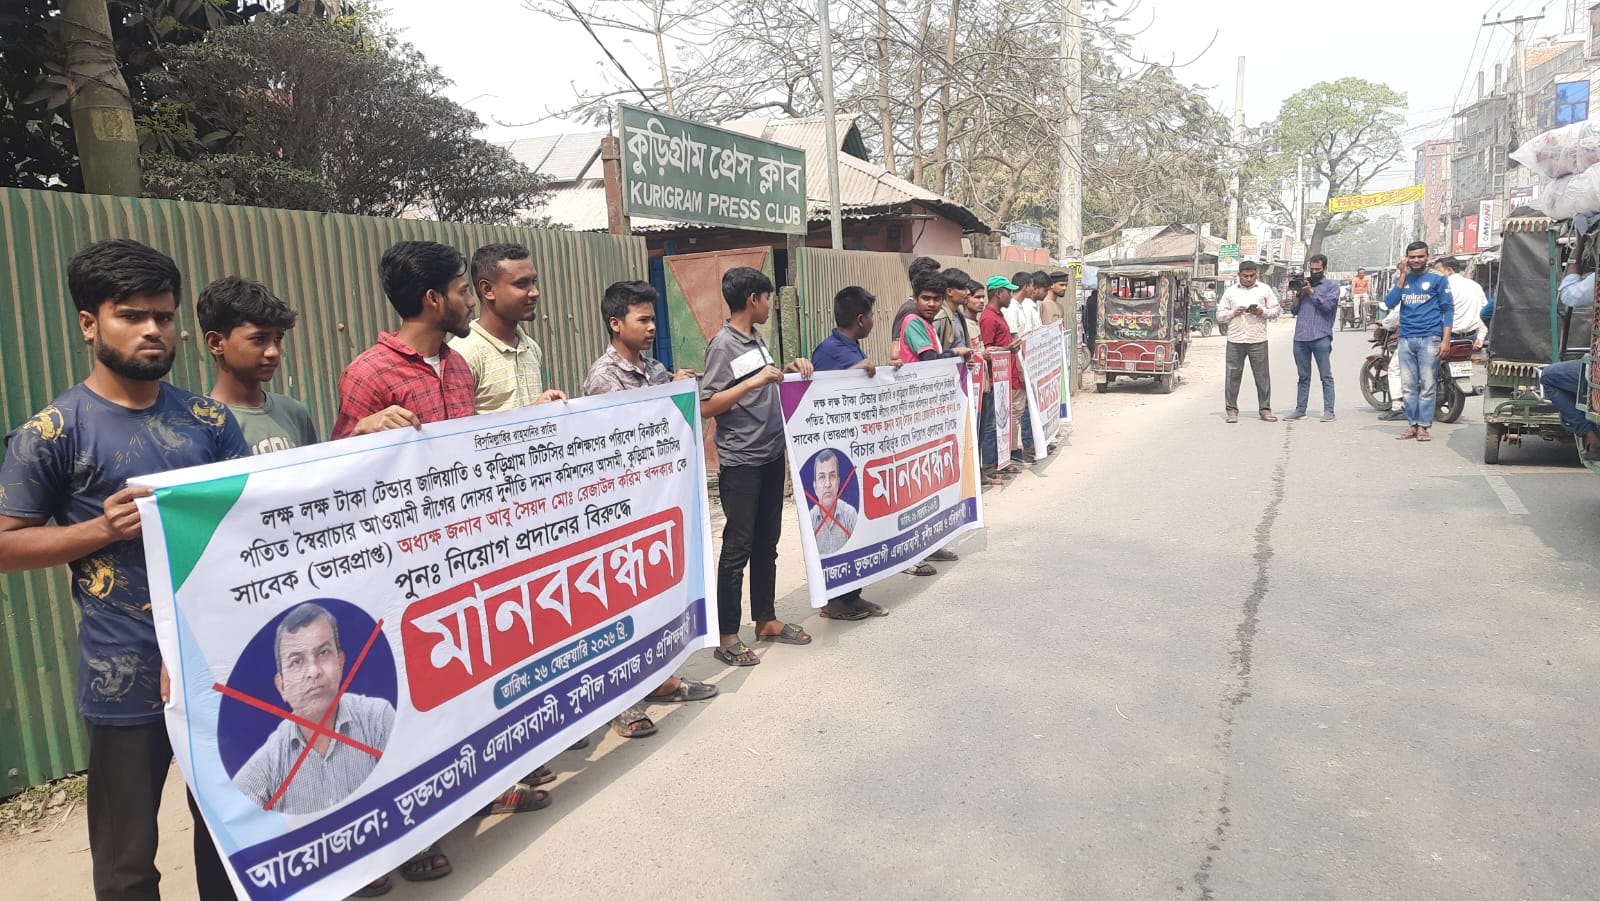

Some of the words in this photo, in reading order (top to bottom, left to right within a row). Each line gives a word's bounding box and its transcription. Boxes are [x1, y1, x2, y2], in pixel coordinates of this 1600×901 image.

[625, 117, 707, 176] কুড়িগ্রাম
[710, 143, 753, 184] প্রেস
[758, 154, 801, 195] ক্লাব
[630, 180, 703, 213] KURIGRAM
[708, 194, 761, 221] PRESS
[766, 203, 801, 225] CLUB
[792, 430, 821, 446] সাবেক
[823, 426, 859, 445] (ভারপ্রাপ্ত)
[805, 413, 825, 429] পতিত
[842, 394, 857, 407] টাকা
[260, 505, 294, 530] লক্ষ
[299, 497, 329, 521] লক্ষ
[334, 488, 366, 512] টাকা
[371, 478, 412, 505] টেন্ডার
[416, 461, 469, 493] জালিয়াতি
[472, 464, 483, 477] ও
[484, 452, 526, 480] কুড়িগ্রাম
[528, 441, 564, 465] টিটিসির
[567, 434, 606, 458] প্রশিক্ষণের
[608, 427, 636, 446] পরিবেশ
[850, 441, 875, 458] বিচার
[866, 439, 955, 507] মানববন্ধন
[230, 569, 299, 605] সাবেক
[307, 541, 393, 590] (ভারপ্রাপ্ত)
[397, 527, 442, 555] অধ্যক্ষ
[444, 515, 482, 541] জনাব
[486, 504, 513, 527] আবু
[513, 495, 547, 521] সৈয়দ
[551, 490, 574, 510] মোঃ
[577, 476, 615, 502] রেজাউল
[618, 468, 641, 487] করিম
[643, 461, 674, 480] খন্দকার
[676, 456, 688, 473] কে
[240, 537, 289, 568] পতিত
[293, 521, 355, 555] স্বৈরাচার
[360, 504, 418, 536] আওয়ামী
[421, 495, 456, 518] লীগের
[460, 486, 493, 511] দোসর
[496, 475, 527, 503] দুর্নীতি
[530, 472, 552, 488] দমন
[555, 462, 595, 482] কমিশনের
[596, 450, 626, 472] আসামী,
[627, 446, 655, 469] কুড়িগ্রাম
[656, 438, 681, 458] টিটিসির
[395, 562, 441, 600] পুনঃ
[444, 536, 510, 577] নিয়োগ
[515, 515, 579, 551] প্রদানের
[584, 498, 632, 531] বিরুদ্ধে
[409, 519, 677, 679] মানববন্ধন
[533, 665, 548, 681] ২৬
[551, 639, 588, 675] ফেব্রুয়ারি
[591, 632, 616, 652] ২০২৬
[246, 807, 388, 889] আয়োজনে:
[482, 694, 565, 761] এলাকাবাসী,
[567, 674, 605, 714] সুশীল
[608, 653, 641, 687] সমাজ
[645, 648, 653, 665] ও
